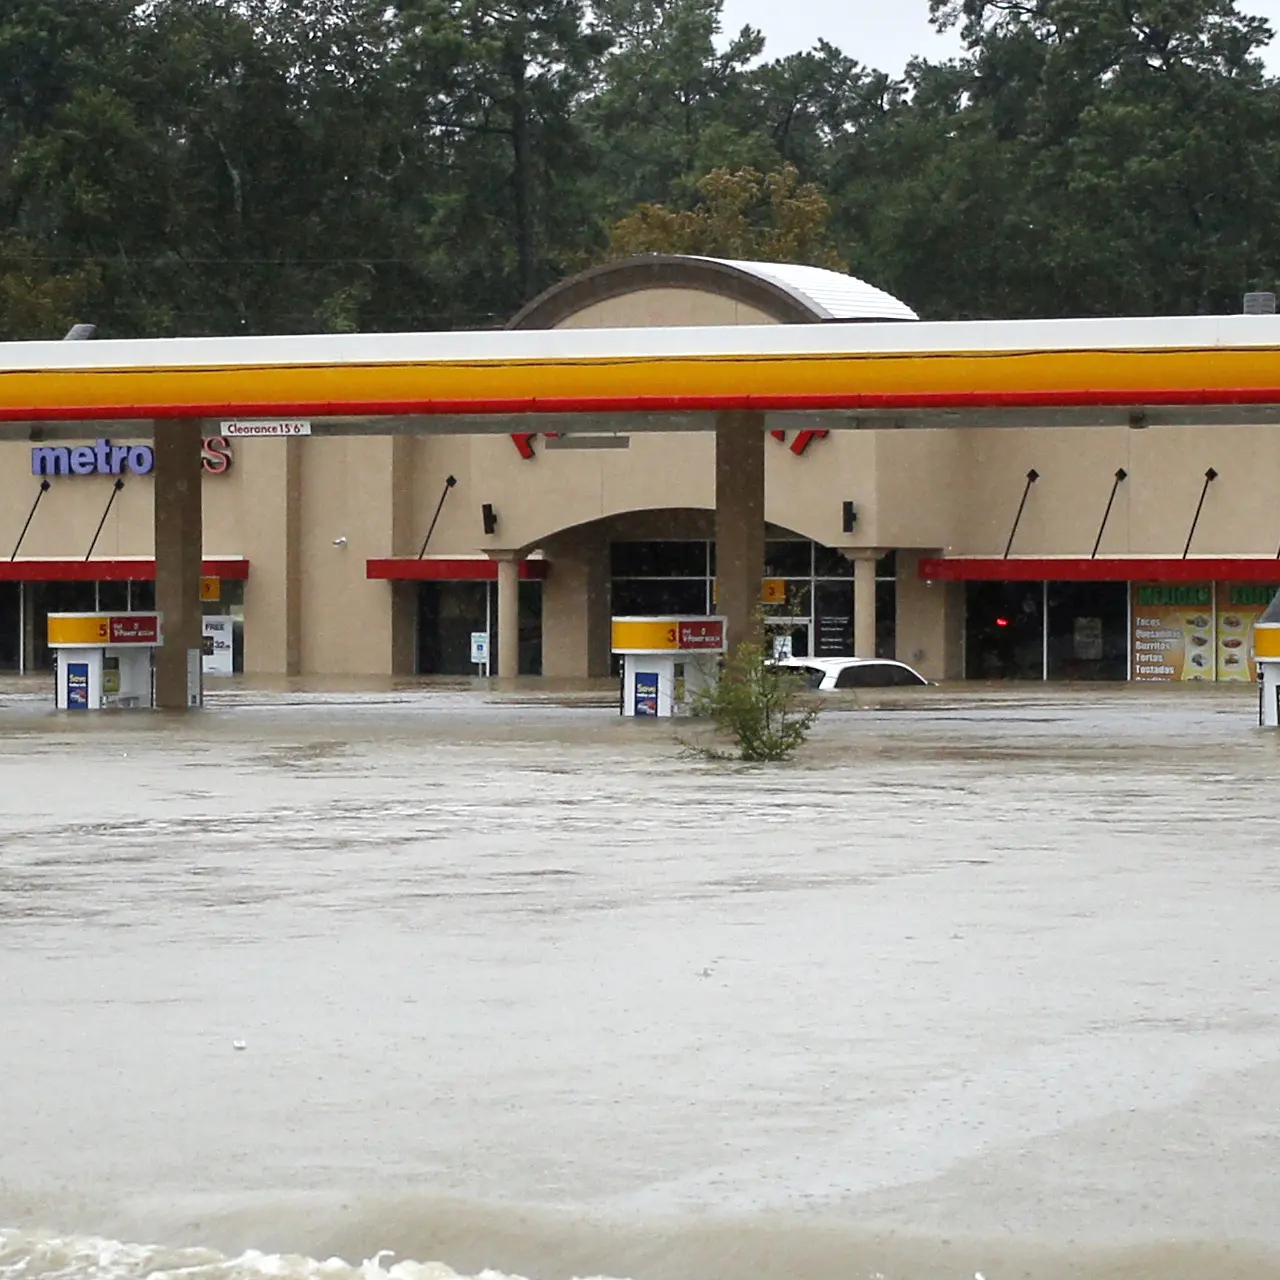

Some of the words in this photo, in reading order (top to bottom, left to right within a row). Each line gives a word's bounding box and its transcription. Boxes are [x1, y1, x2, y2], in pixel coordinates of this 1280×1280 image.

[227, 422, 278, 434] Clearance
[1136, 617, 1161, 626] Tacos
[96, 624, 106, 637] 5
[205, 623, 224, 631] FREE
[667, 628, 676, 643] 3
[1136, 653, 1163, 662] Tortas
[1136, 665, 1175, 674] Tostadas
